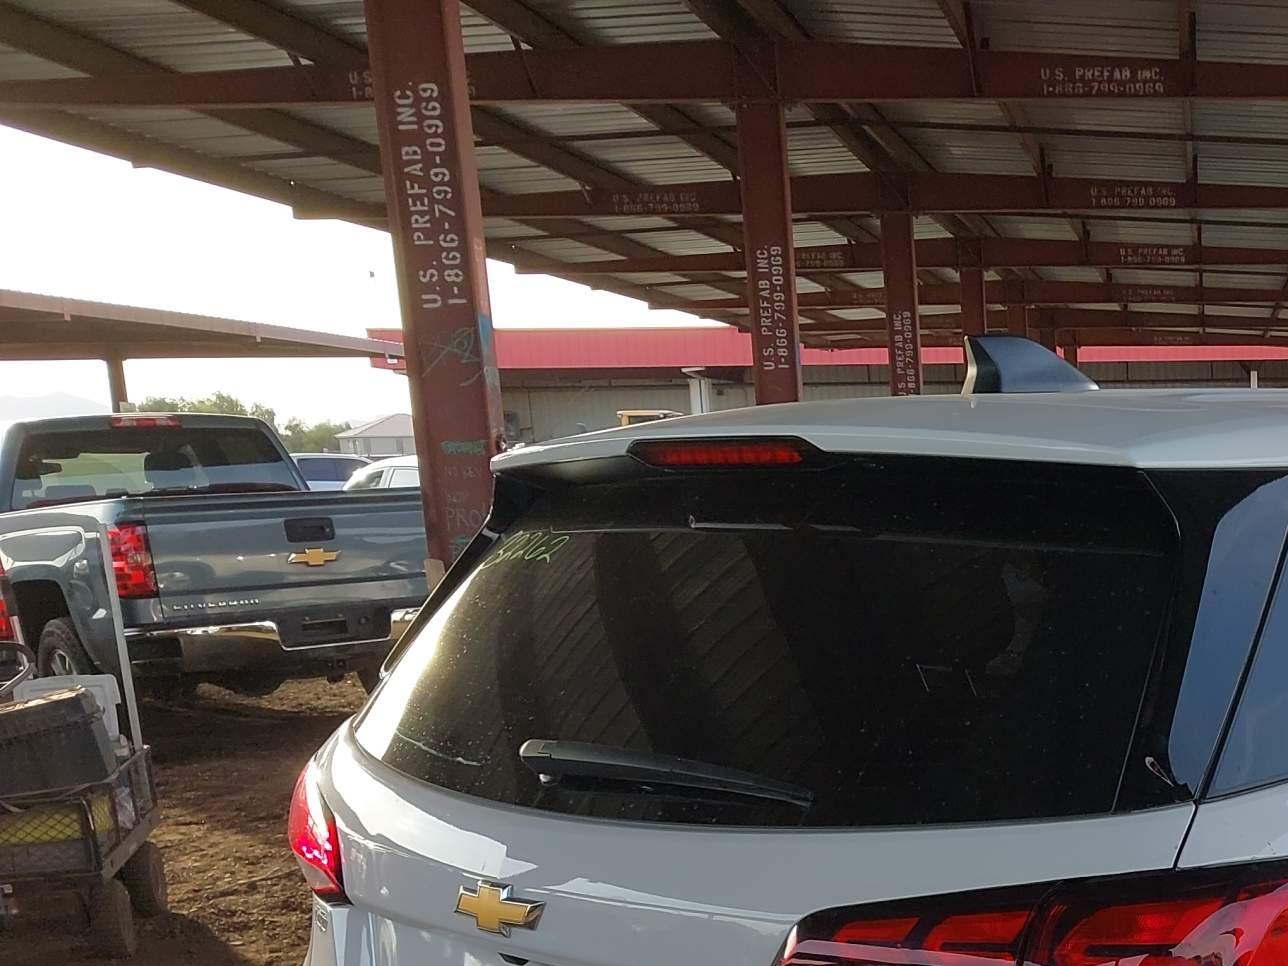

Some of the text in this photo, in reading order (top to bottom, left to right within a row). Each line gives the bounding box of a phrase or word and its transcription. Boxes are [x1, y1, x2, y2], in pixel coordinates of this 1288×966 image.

[1041, 66, 1069, 81] U.S.
[1075, 66, 1131, 81] PREFAB
[394, 80, 443, 309] U.S. PREFAB INC.
[418, 82, 468, 305] 1-866-799-0969
[756, 245, 776, 371] U.S. PREFAB INC.
[770, 246, 790, 369] 1-866-799-0969
[902, 311, 916, 394] -866-799-0969
